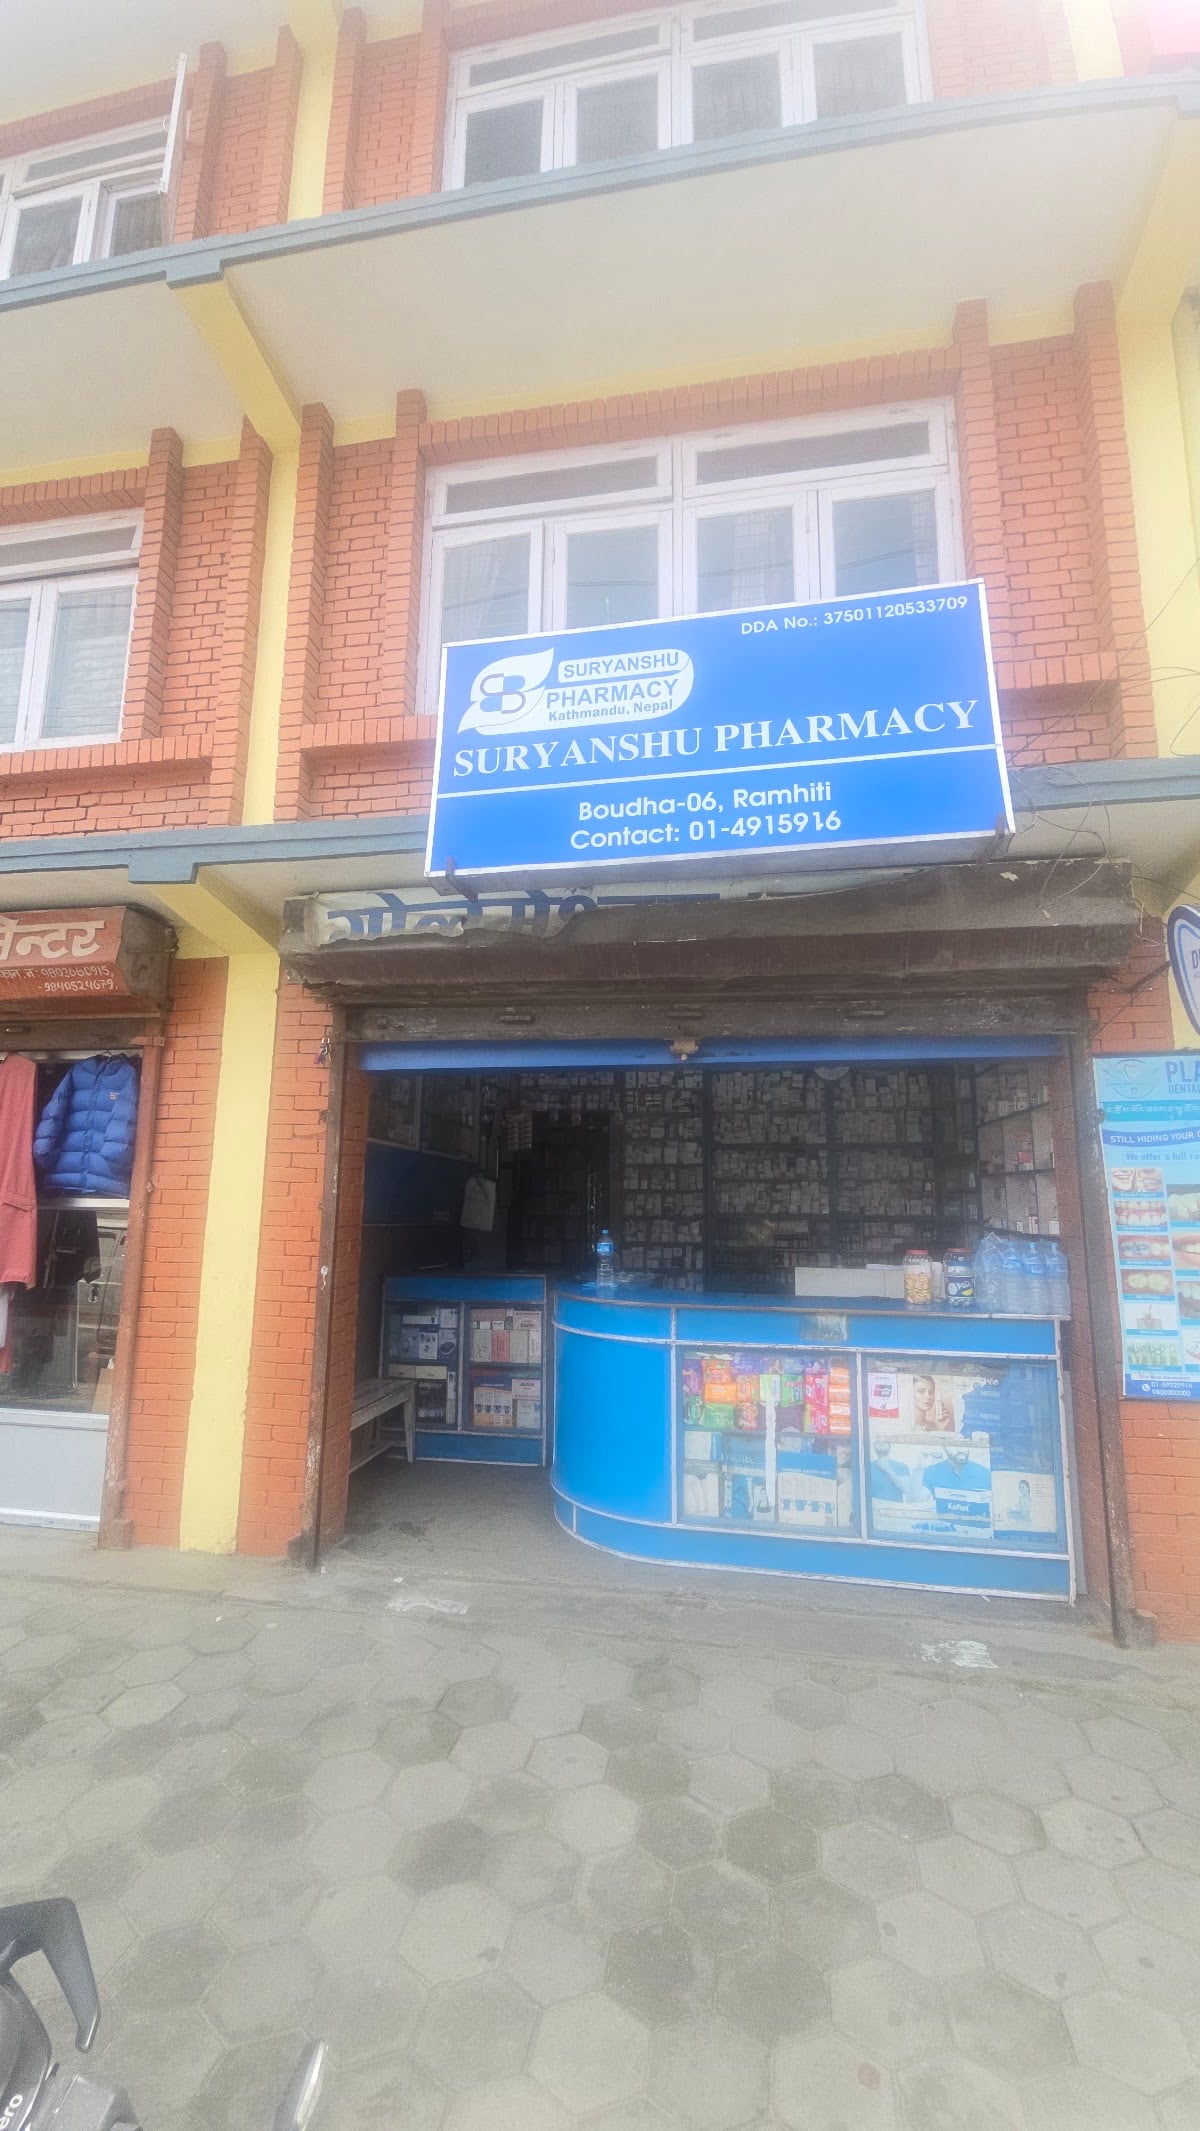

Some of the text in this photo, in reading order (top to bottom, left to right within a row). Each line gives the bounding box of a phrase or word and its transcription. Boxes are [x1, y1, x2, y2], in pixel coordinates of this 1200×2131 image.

[741, 595, 969, 635] DDA No.: 37501120533709
[563, 652, 680, 679] SURYANSHU
[546, 678, 679, 709] PHARMACY
[548, 698, 674, 723] Kathmandu, Nepal
[453, 699, 980, 777] SURYANSHU PHARMACY
[578, 781, 832, 822] Boudha-06, Ramhiti
[570, 810, 842, 850] Contact: 01-4915916
[1110, 1135, 1135, 1144] STILL
[1137, 1134, 1169, 1143] HIDING
[1170, 1131, 1195, 1141] YOUR
[1126, 1153, 1139, 1161] We
[1172, 1152, 1187, 1161] full
